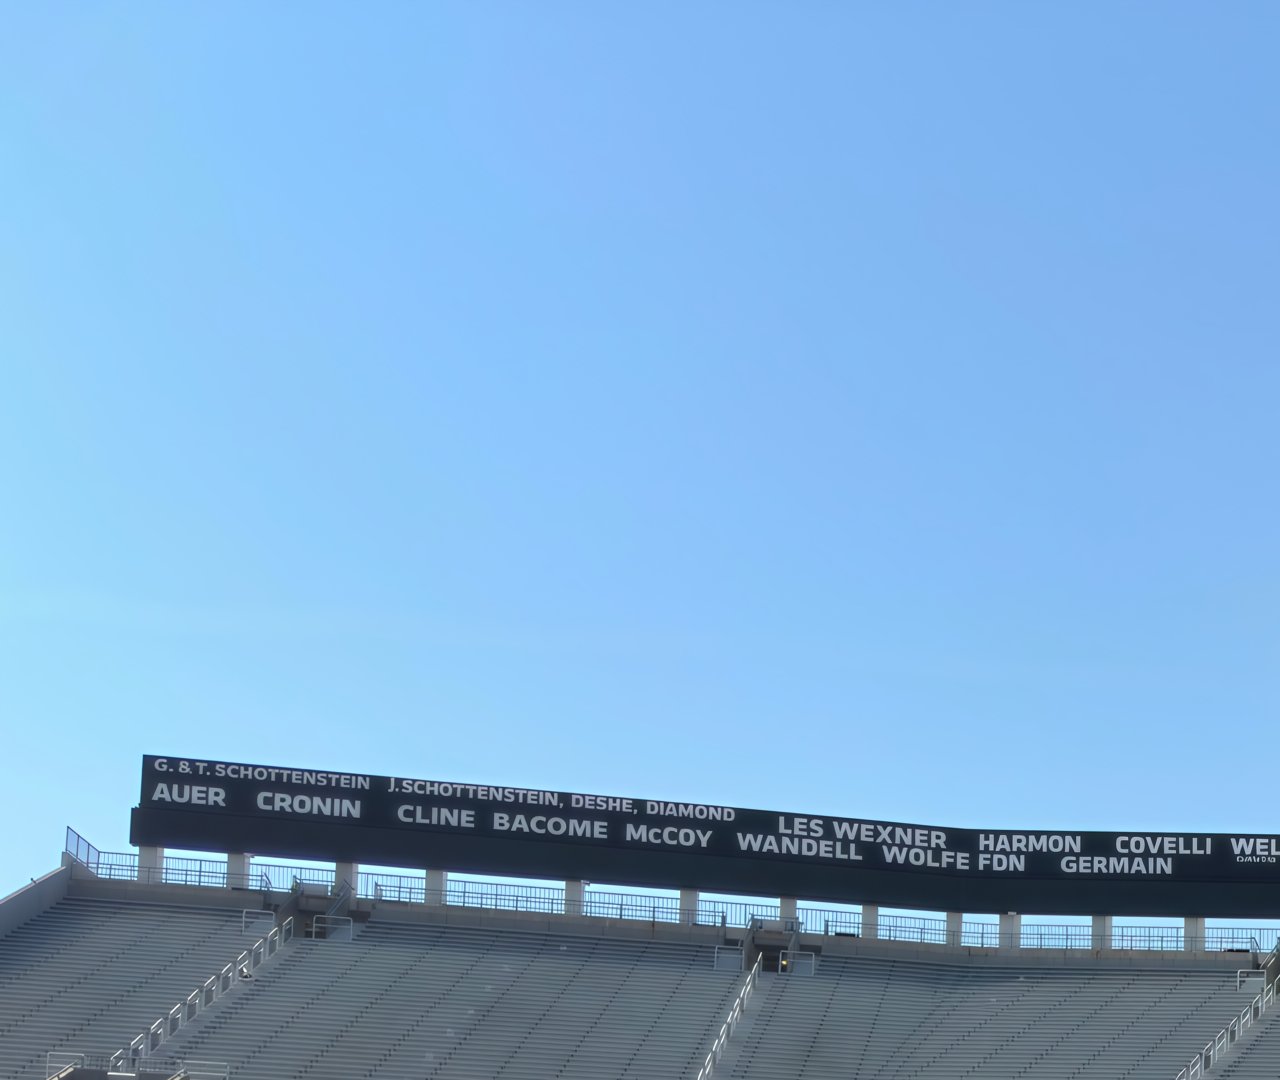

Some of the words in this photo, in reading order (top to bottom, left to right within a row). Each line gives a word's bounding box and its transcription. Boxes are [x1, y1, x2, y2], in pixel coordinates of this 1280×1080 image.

[154, 758, 174, 772] G.
[196, 762, 210, 776] T.
[215, 764, 370, 790] SCHOTTENSTEIN
[152, 782, 226, 807] AUER
[256, 791, 361, 818] CRONIN
[398, 804, 475, 828] CLINE
[571, 794, 638, 813] DESHE,
[646, 801, 735, 822] DIAMOND
[494, 813, 608, 839] BACOME
[626, 823, 712, 848] McCOY
[778, 816, 824, 837] LES
[832, 821, 946, 849] WEXNER
[737, 833, 862, 860] WANDELL
[979, 834, 1081, 853] HARMON
[1116, 836, 1212, 855] COVELLI
[882, 846, 969, 870] WOLFE
[978, 854, 1024, 872] FDN
[1060, 856, 1172, 874] GERMAIN
